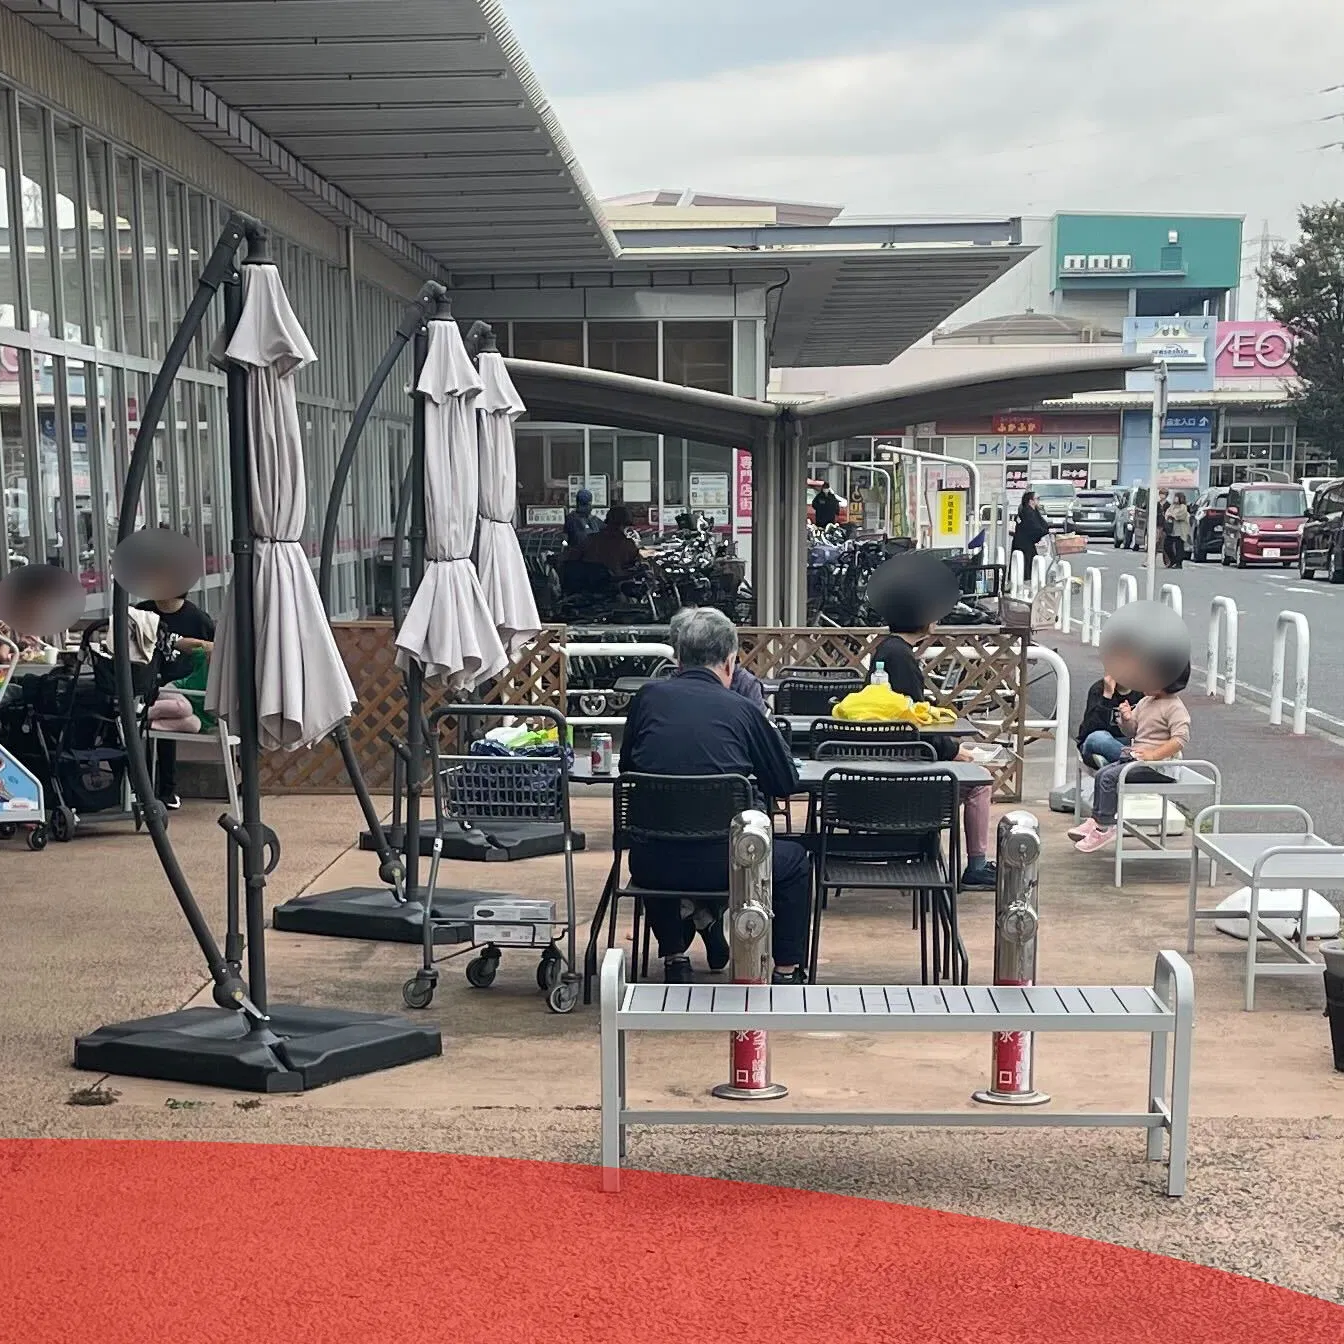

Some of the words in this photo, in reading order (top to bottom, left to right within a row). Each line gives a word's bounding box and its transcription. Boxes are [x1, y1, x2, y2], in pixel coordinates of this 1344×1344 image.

[1216, 329, 1293, 368] AEO
[978, 441, 1087, 455] コインランドリー
